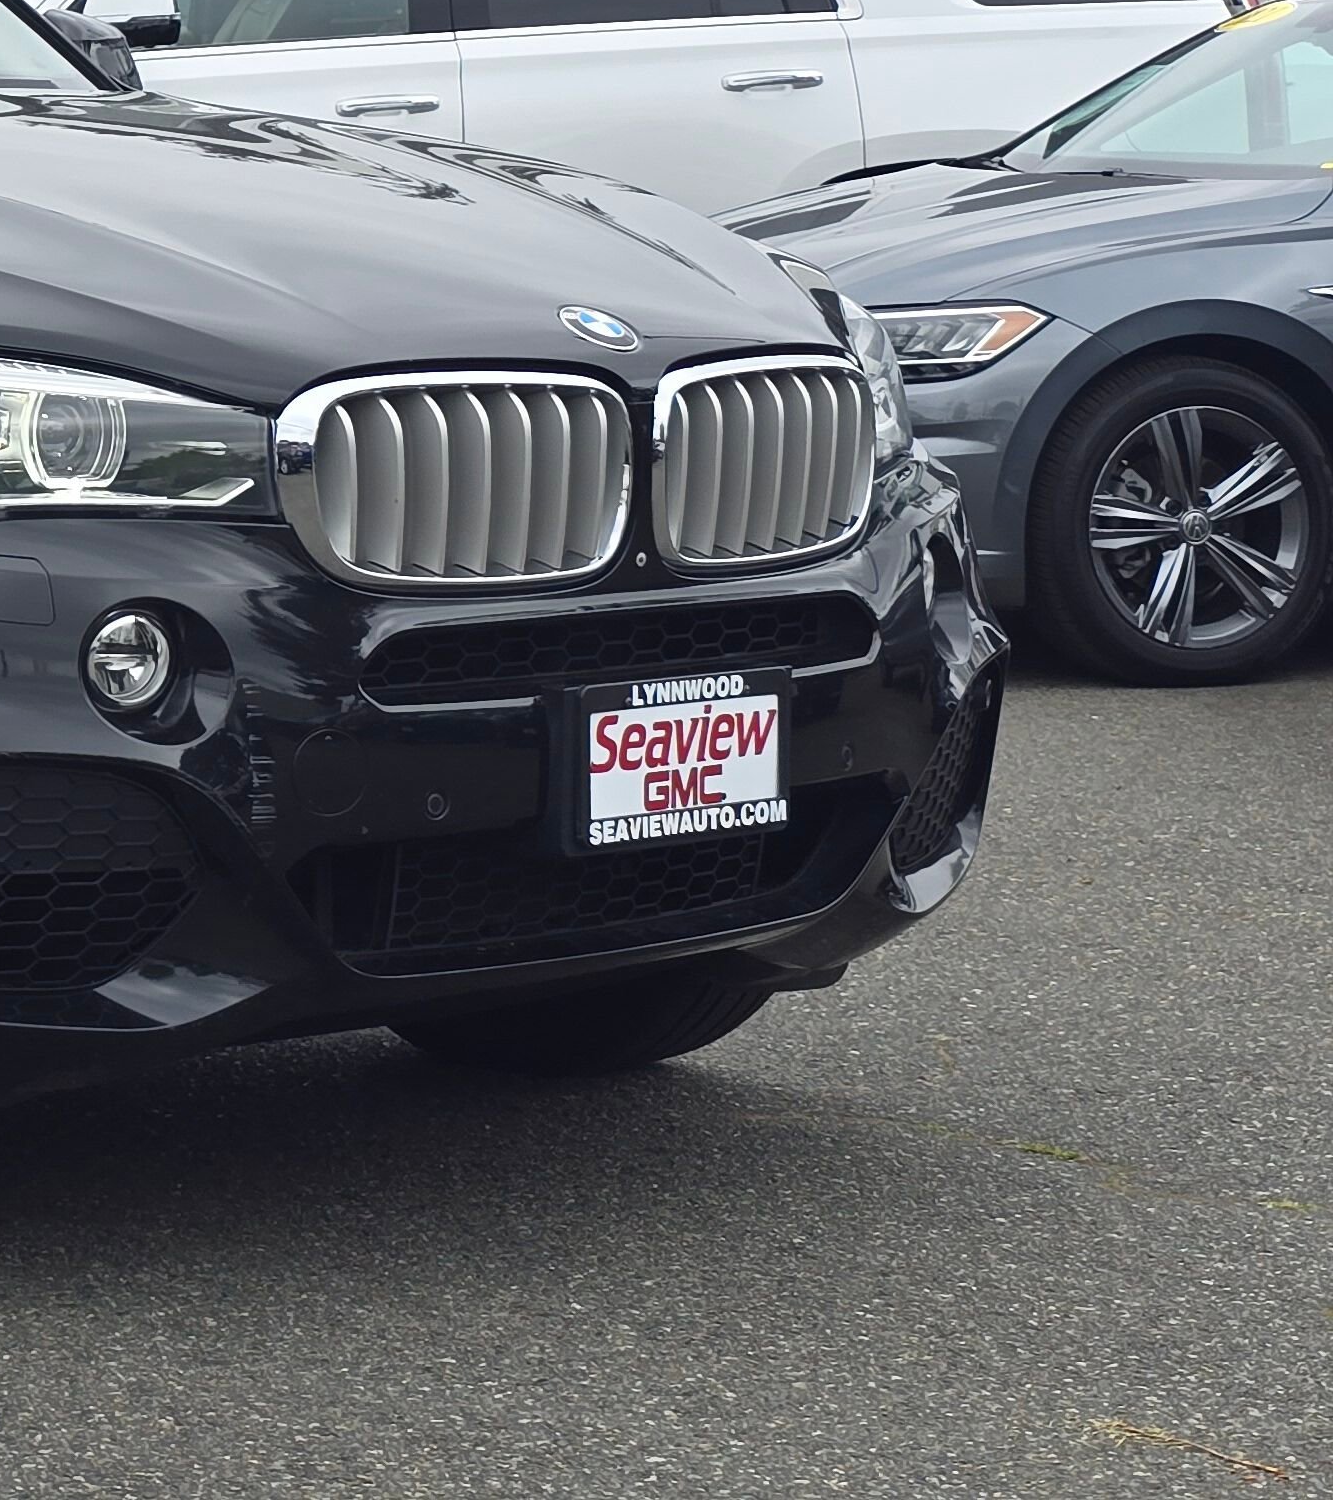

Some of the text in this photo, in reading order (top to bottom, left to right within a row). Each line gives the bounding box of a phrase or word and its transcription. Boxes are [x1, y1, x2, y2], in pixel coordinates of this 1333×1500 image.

[631, 674, 745, 707] LYNNWOOD
[589, 704, 778, 774] Seaview
[643, 764, 727, 812] GMC
[589, 799, 788, 847] SEAVIEWAUTO.COM
